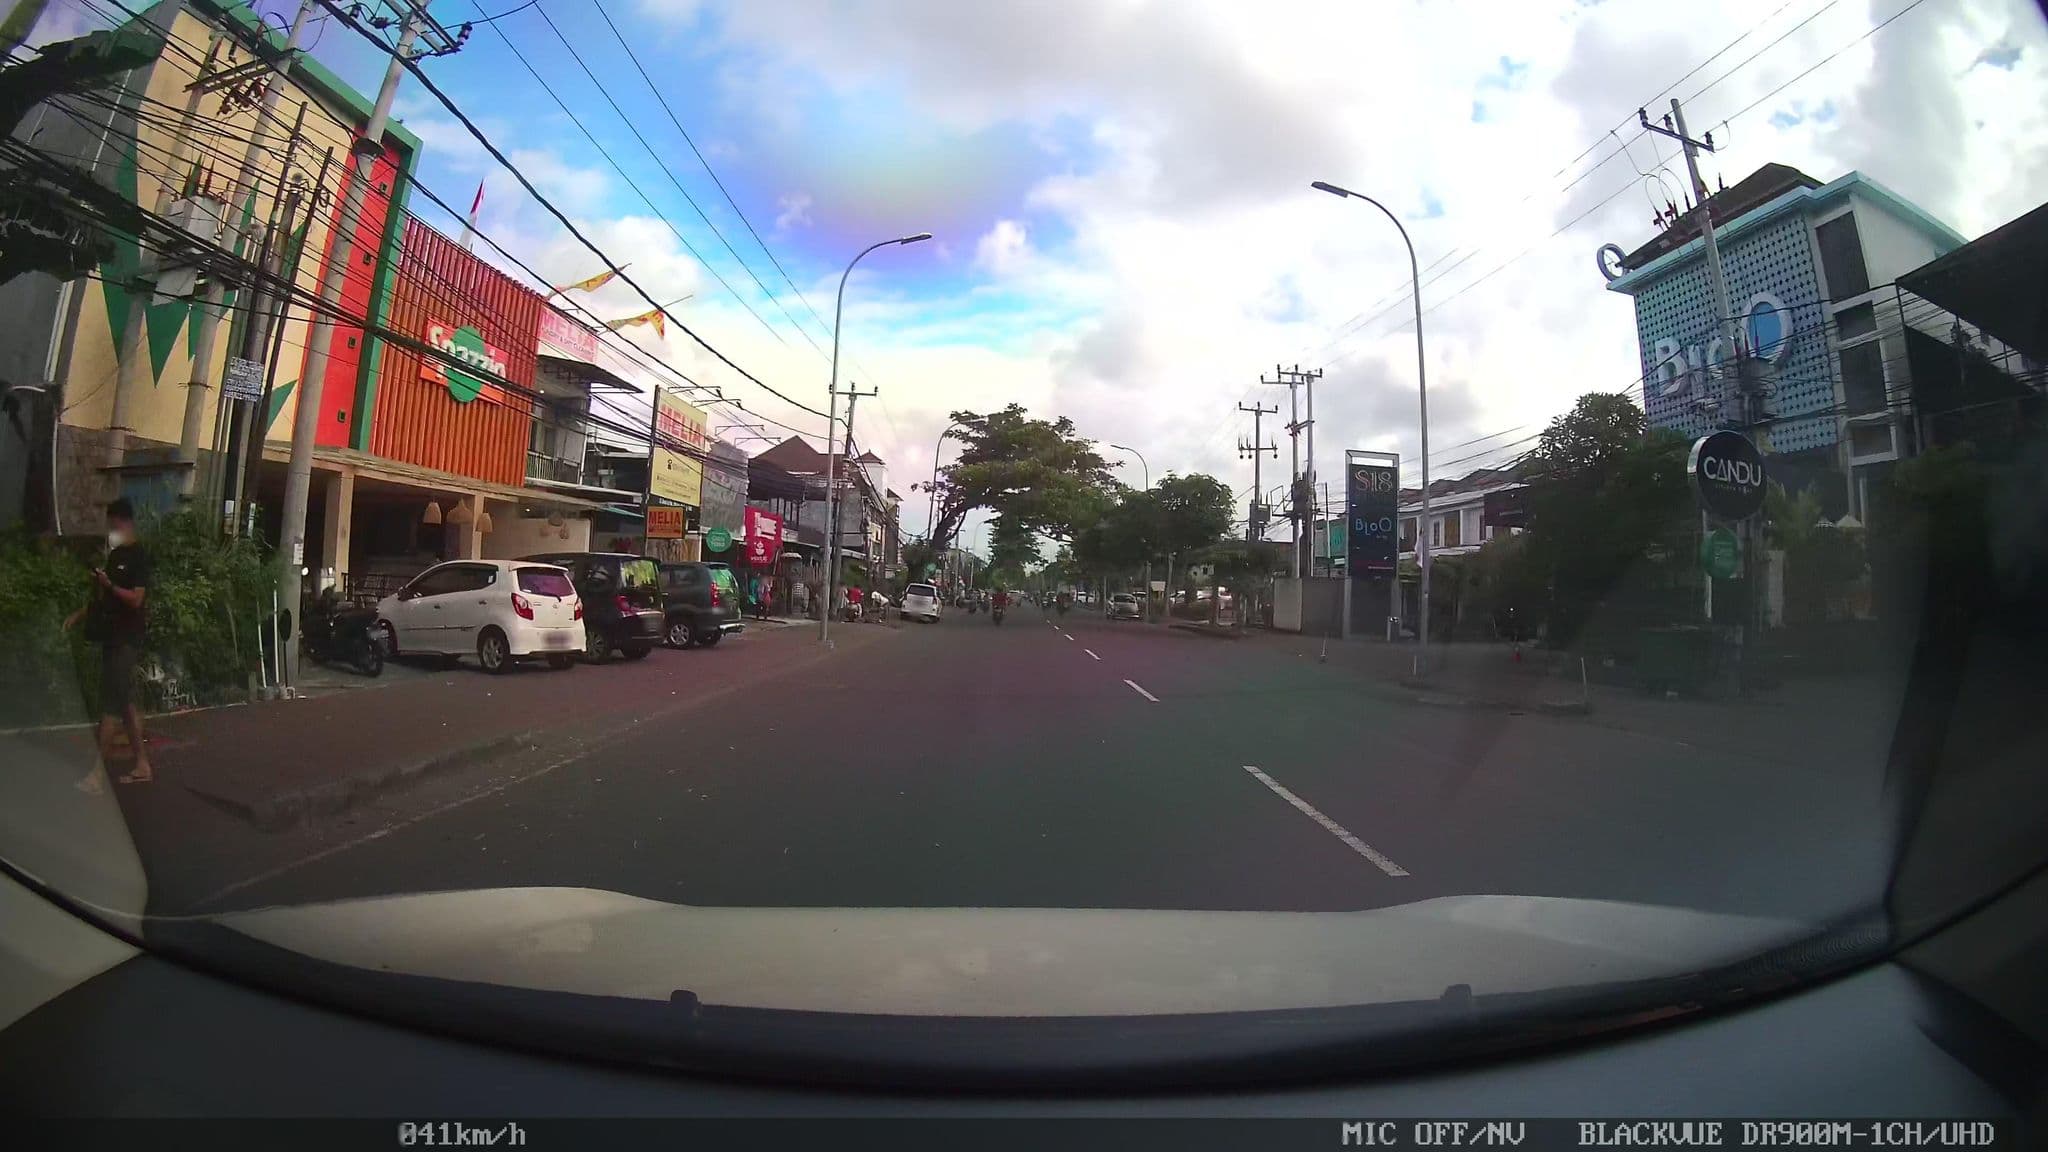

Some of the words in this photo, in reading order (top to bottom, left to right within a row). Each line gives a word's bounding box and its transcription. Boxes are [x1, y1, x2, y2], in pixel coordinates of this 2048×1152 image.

[658, 403, 705, 447] MELIA
[1703, 456, 1762, 487] CANDU
[648, 511, 681, 525] MELIA
